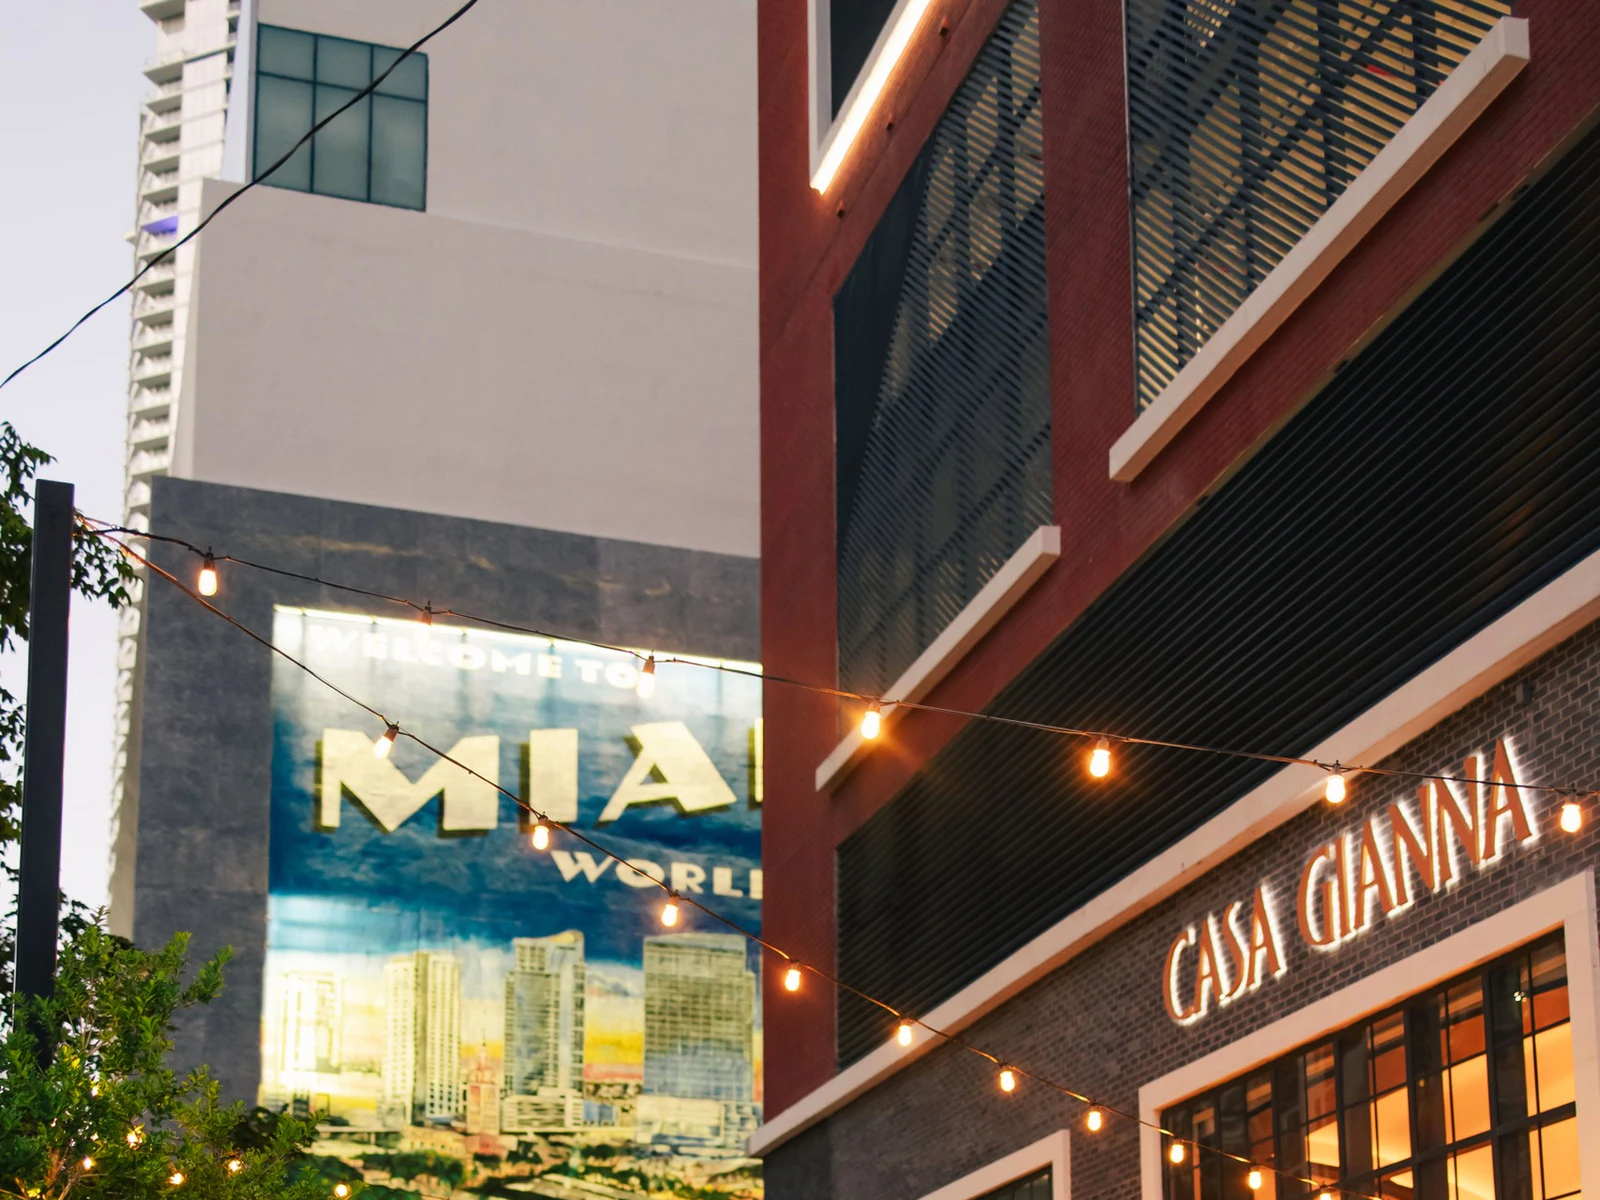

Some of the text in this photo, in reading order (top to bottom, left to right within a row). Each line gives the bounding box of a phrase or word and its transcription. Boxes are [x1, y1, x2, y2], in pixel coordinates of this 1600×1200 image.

[309, 622, 639, 690] WELCOME TO
[312, 718, 763, 838] MIA
[1163, 737, 1536, 1024] CASA GIANNA
